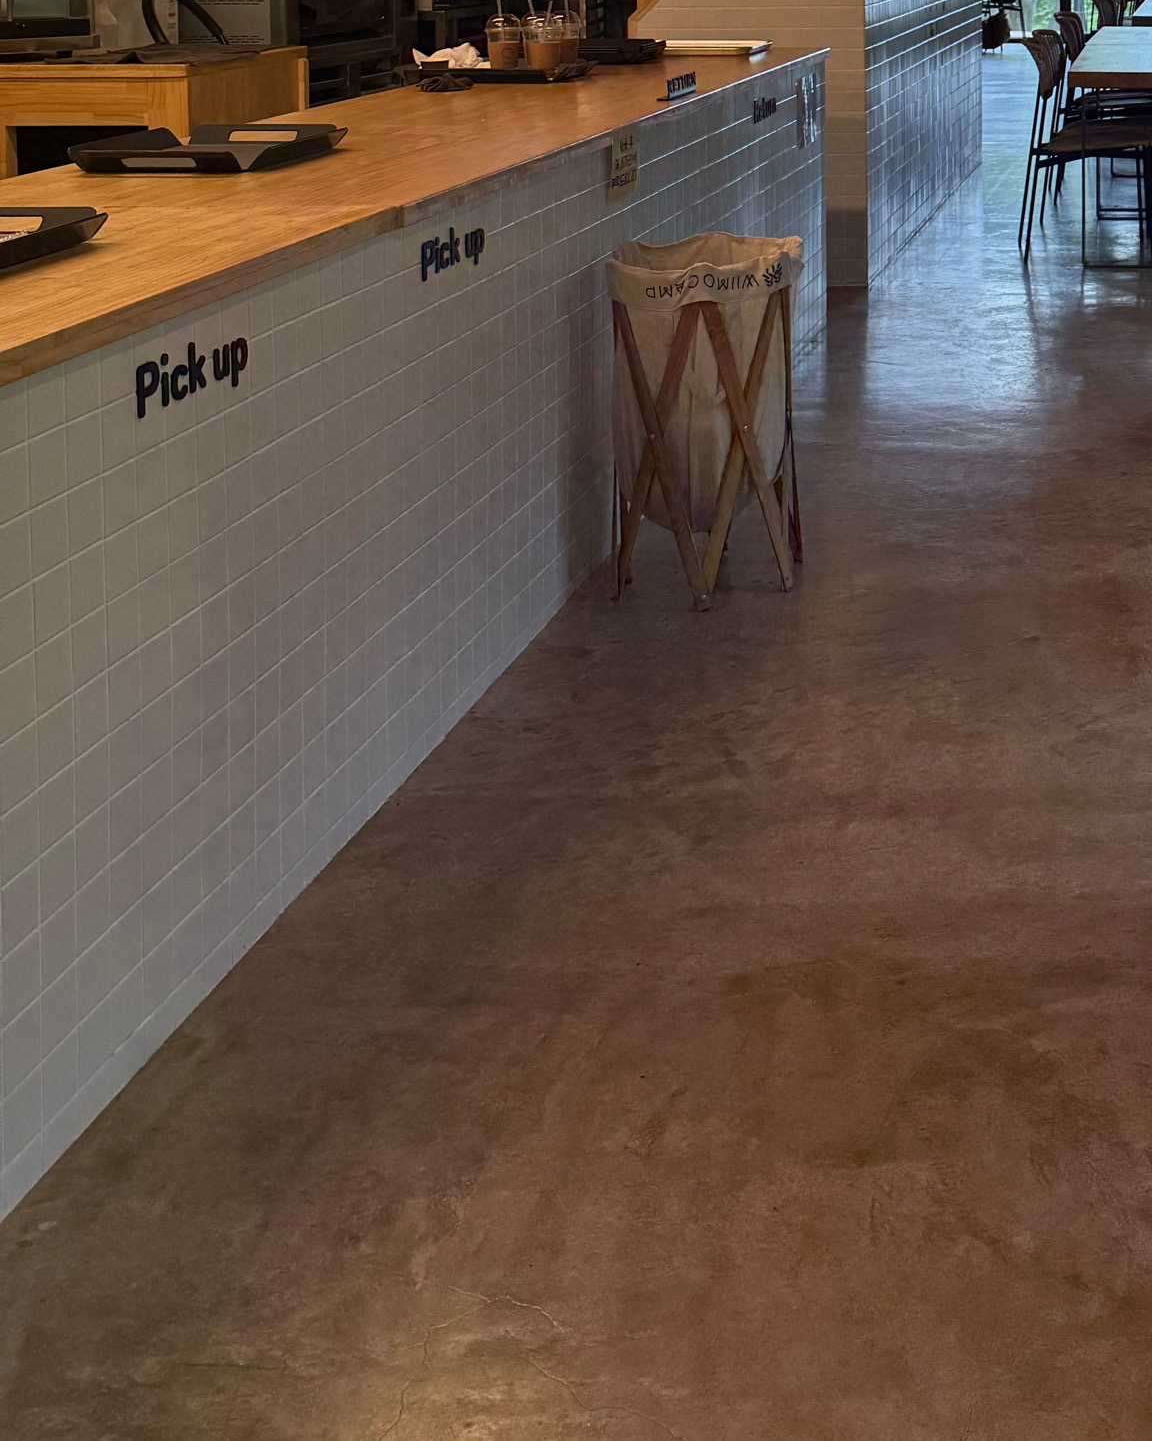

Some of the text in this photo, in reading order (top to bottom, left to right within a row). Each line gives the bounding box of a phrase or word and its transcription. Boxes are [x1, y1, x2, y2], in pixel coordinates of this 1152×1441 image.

[667, 71, 696, 93] RETURN
[753, 98, 777, 124] Return
[421, 227, 485, 281] Pick up
[136, 338, 248, 419] Pick up
